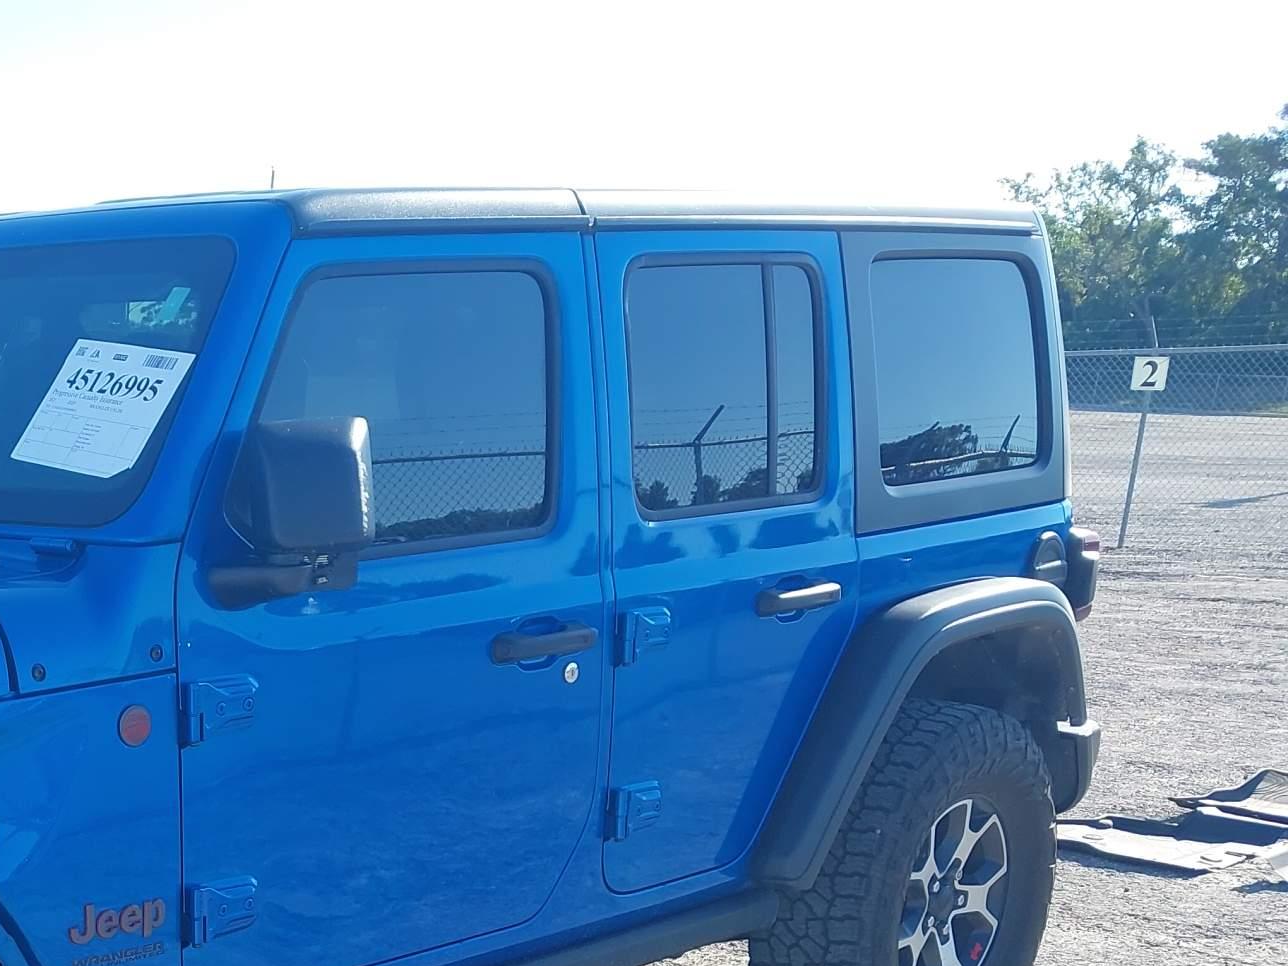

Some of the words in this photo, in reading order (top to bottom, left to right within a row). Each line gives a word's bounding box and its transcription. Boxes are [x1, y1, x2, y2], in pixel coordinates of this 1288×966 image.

[67, 367, 164, 402] 45126995
[1140, 360, 1158, 387] 2
[69, 898, 165, 944] Jeep
